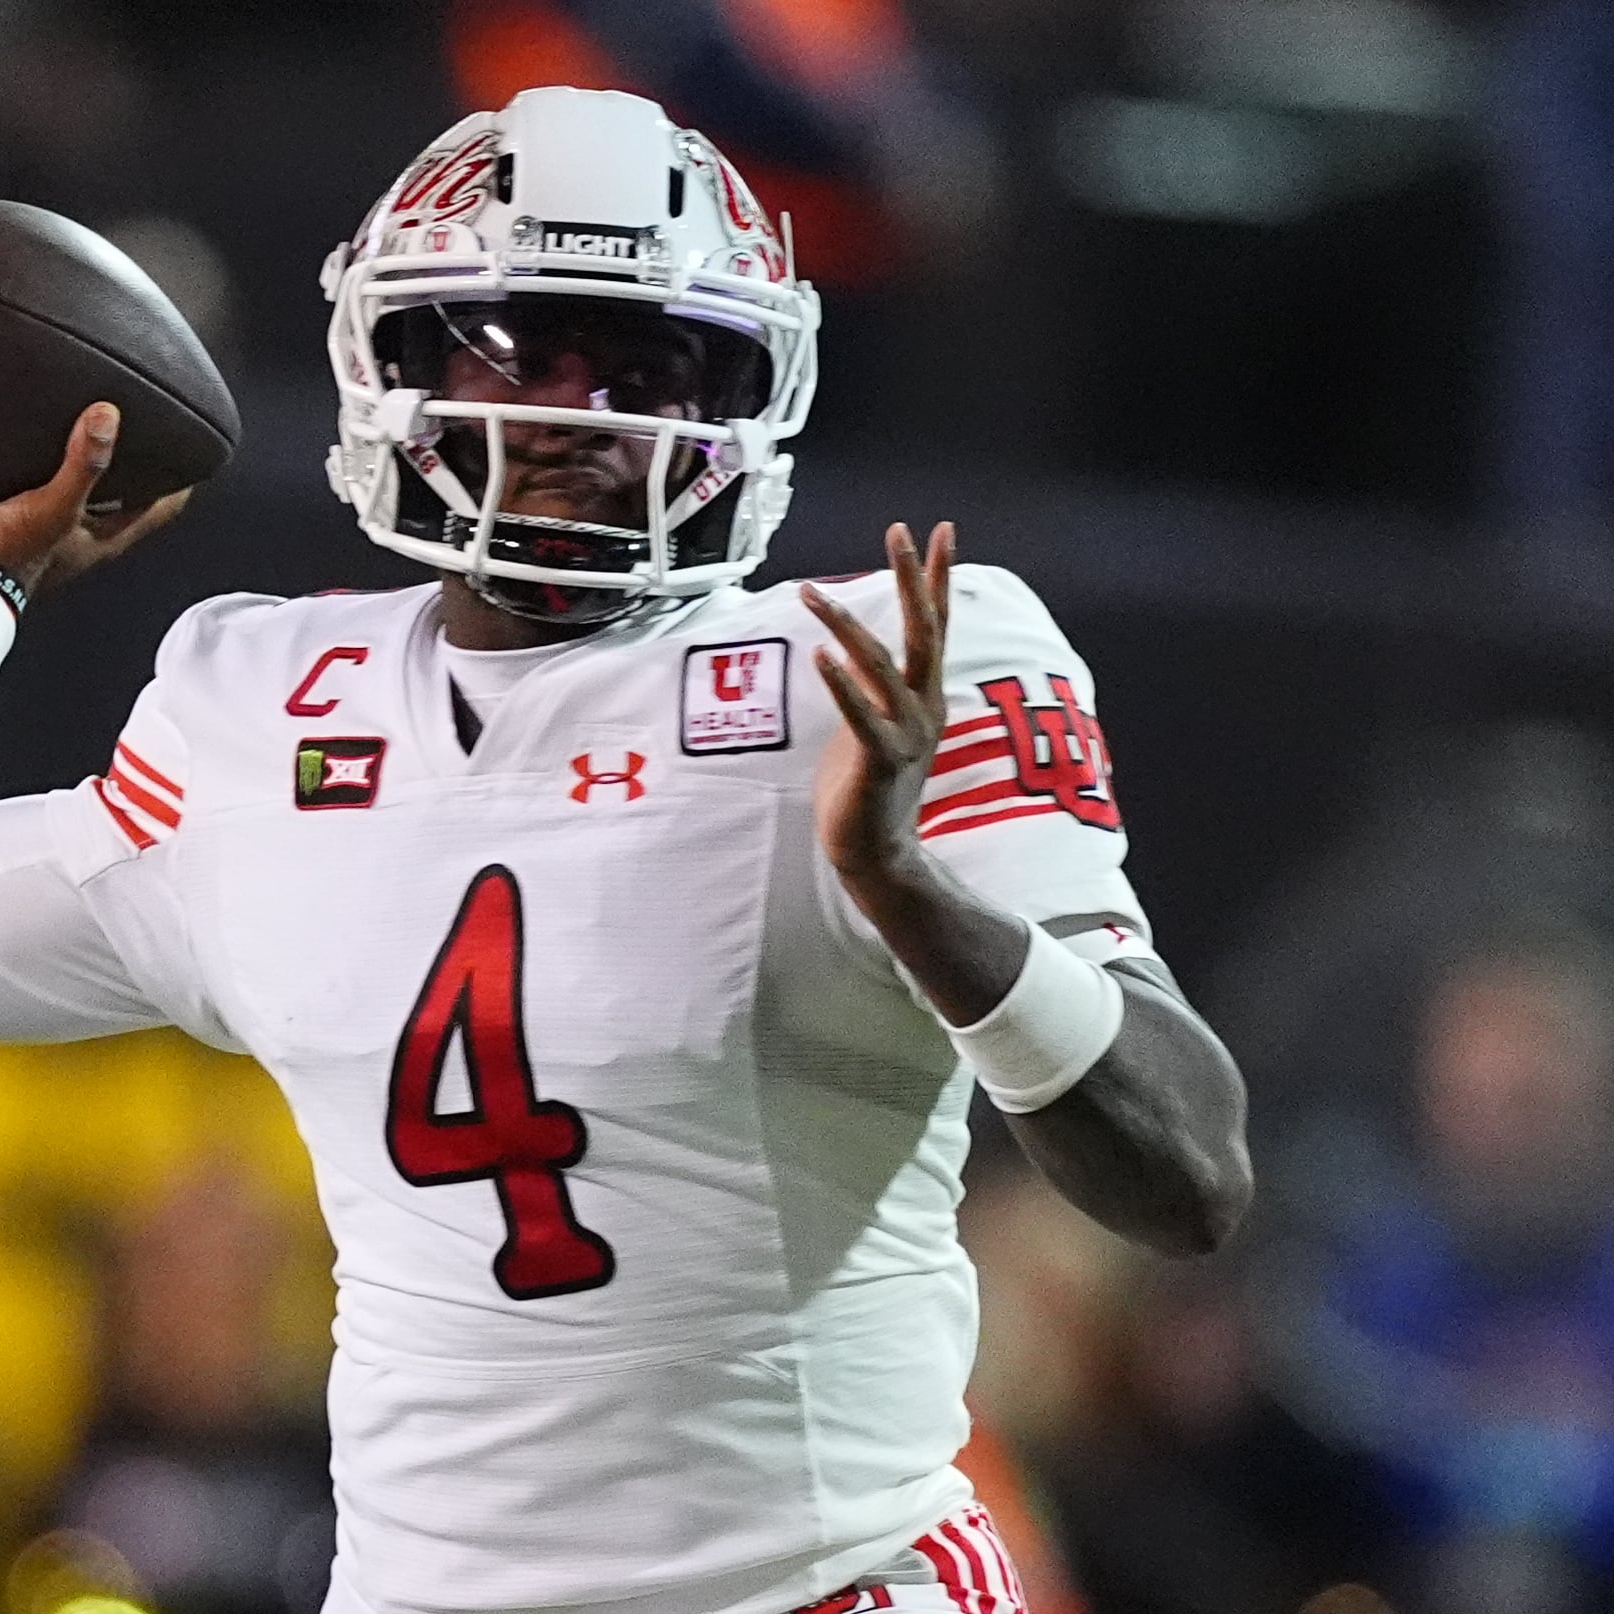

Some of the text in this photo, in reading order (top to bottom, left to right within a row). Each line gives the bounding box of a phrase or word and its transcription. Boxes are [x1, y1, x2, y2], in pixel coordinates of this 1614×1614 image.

[544, 232, 635, 258] LIGHT
[285, 646, 370, 717] C
[688, 707, 779, 731] HEALTH
[386, 863, 617, 1300] 4
